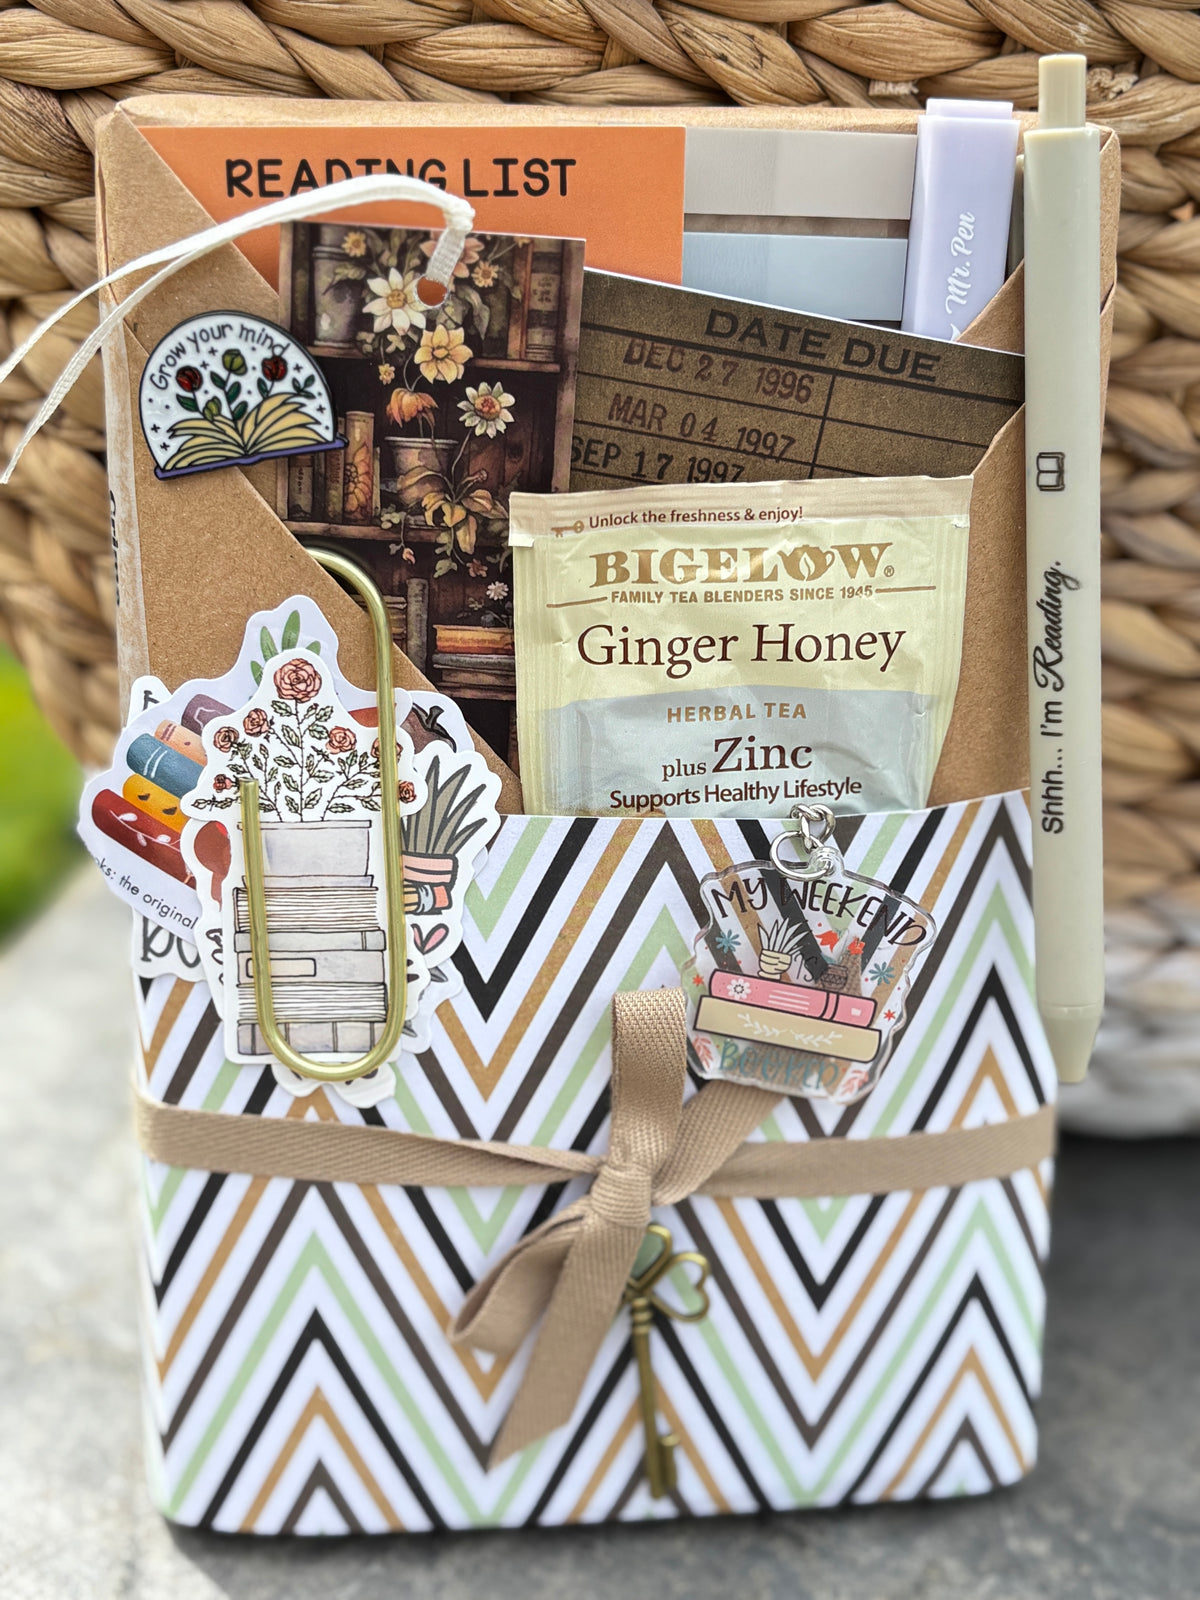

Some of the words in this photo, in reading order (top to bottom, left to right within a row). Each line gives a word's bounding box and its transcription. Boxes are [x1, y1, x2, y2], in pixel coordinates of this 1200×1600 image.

[462, 158, 576, 197] LIST
[950, 211, 976, 257] Pen
[945, 261, 972, 315] Mr.
[150, 342, 187, 391] Grow
[186, 323, 233, 353] your
[238, 323, 291, 357] mind
[623, 338, 684, 373] DEC
[694, 354, 742, 387] 27
[754, 366, 815, 404] 1996
[705, 309, 834, 360] DATE
[842, 338, 941, 383] DUE
[608, 393, 668, 432] MAR
[680, 412, 720, 443] 04
[737, 426, 796, 463] 1997
[571, 435, 622, 468] SEP
[631, 451, 674, 480] 17
[687, 456, 745, 483] 1997
[589, 512, 639, 529] Unlock
[642, 509, 667, 524] the
[670, 507, 741, 523] freshness
[744, 508, 756, 521] &
[758, 506, 803, 525] enjoy!
[611, 591, 663, 604] FAMILY
[670, 590, 698, 603] TEA
[704, 588, 784, 603] BLENDERS
[790, 587, 834, 601] SINCE
[840, 585, 873, 599] 1945
[577, 624, 739, 679] Ginger
[752, 623, 906, 672] Honey
[1032, 560, 1083, 692] Reading.
[666, 703, 757, 723] HERBAL
[764, 702, 807, 720] TEA
[1041, 701, 1063, 736] I'm
[662, 758, 707, 782] plus
[712, 735, 813, 774] Zinc
[610, 790, 700, 813] Supports
[704, 781, 780, 804] Healthy
[783, 776, 862, 800] Lifestyle
[1041, 748, 1064, 834] Shhh...
[119, 875, 140, 895] the
[142, 893, 199, 930] original
[711, 877, 768, 918] MY
[779, 877, 927, 946] WEEKEND
[719, 1039, 839, 1089] BOOKED
